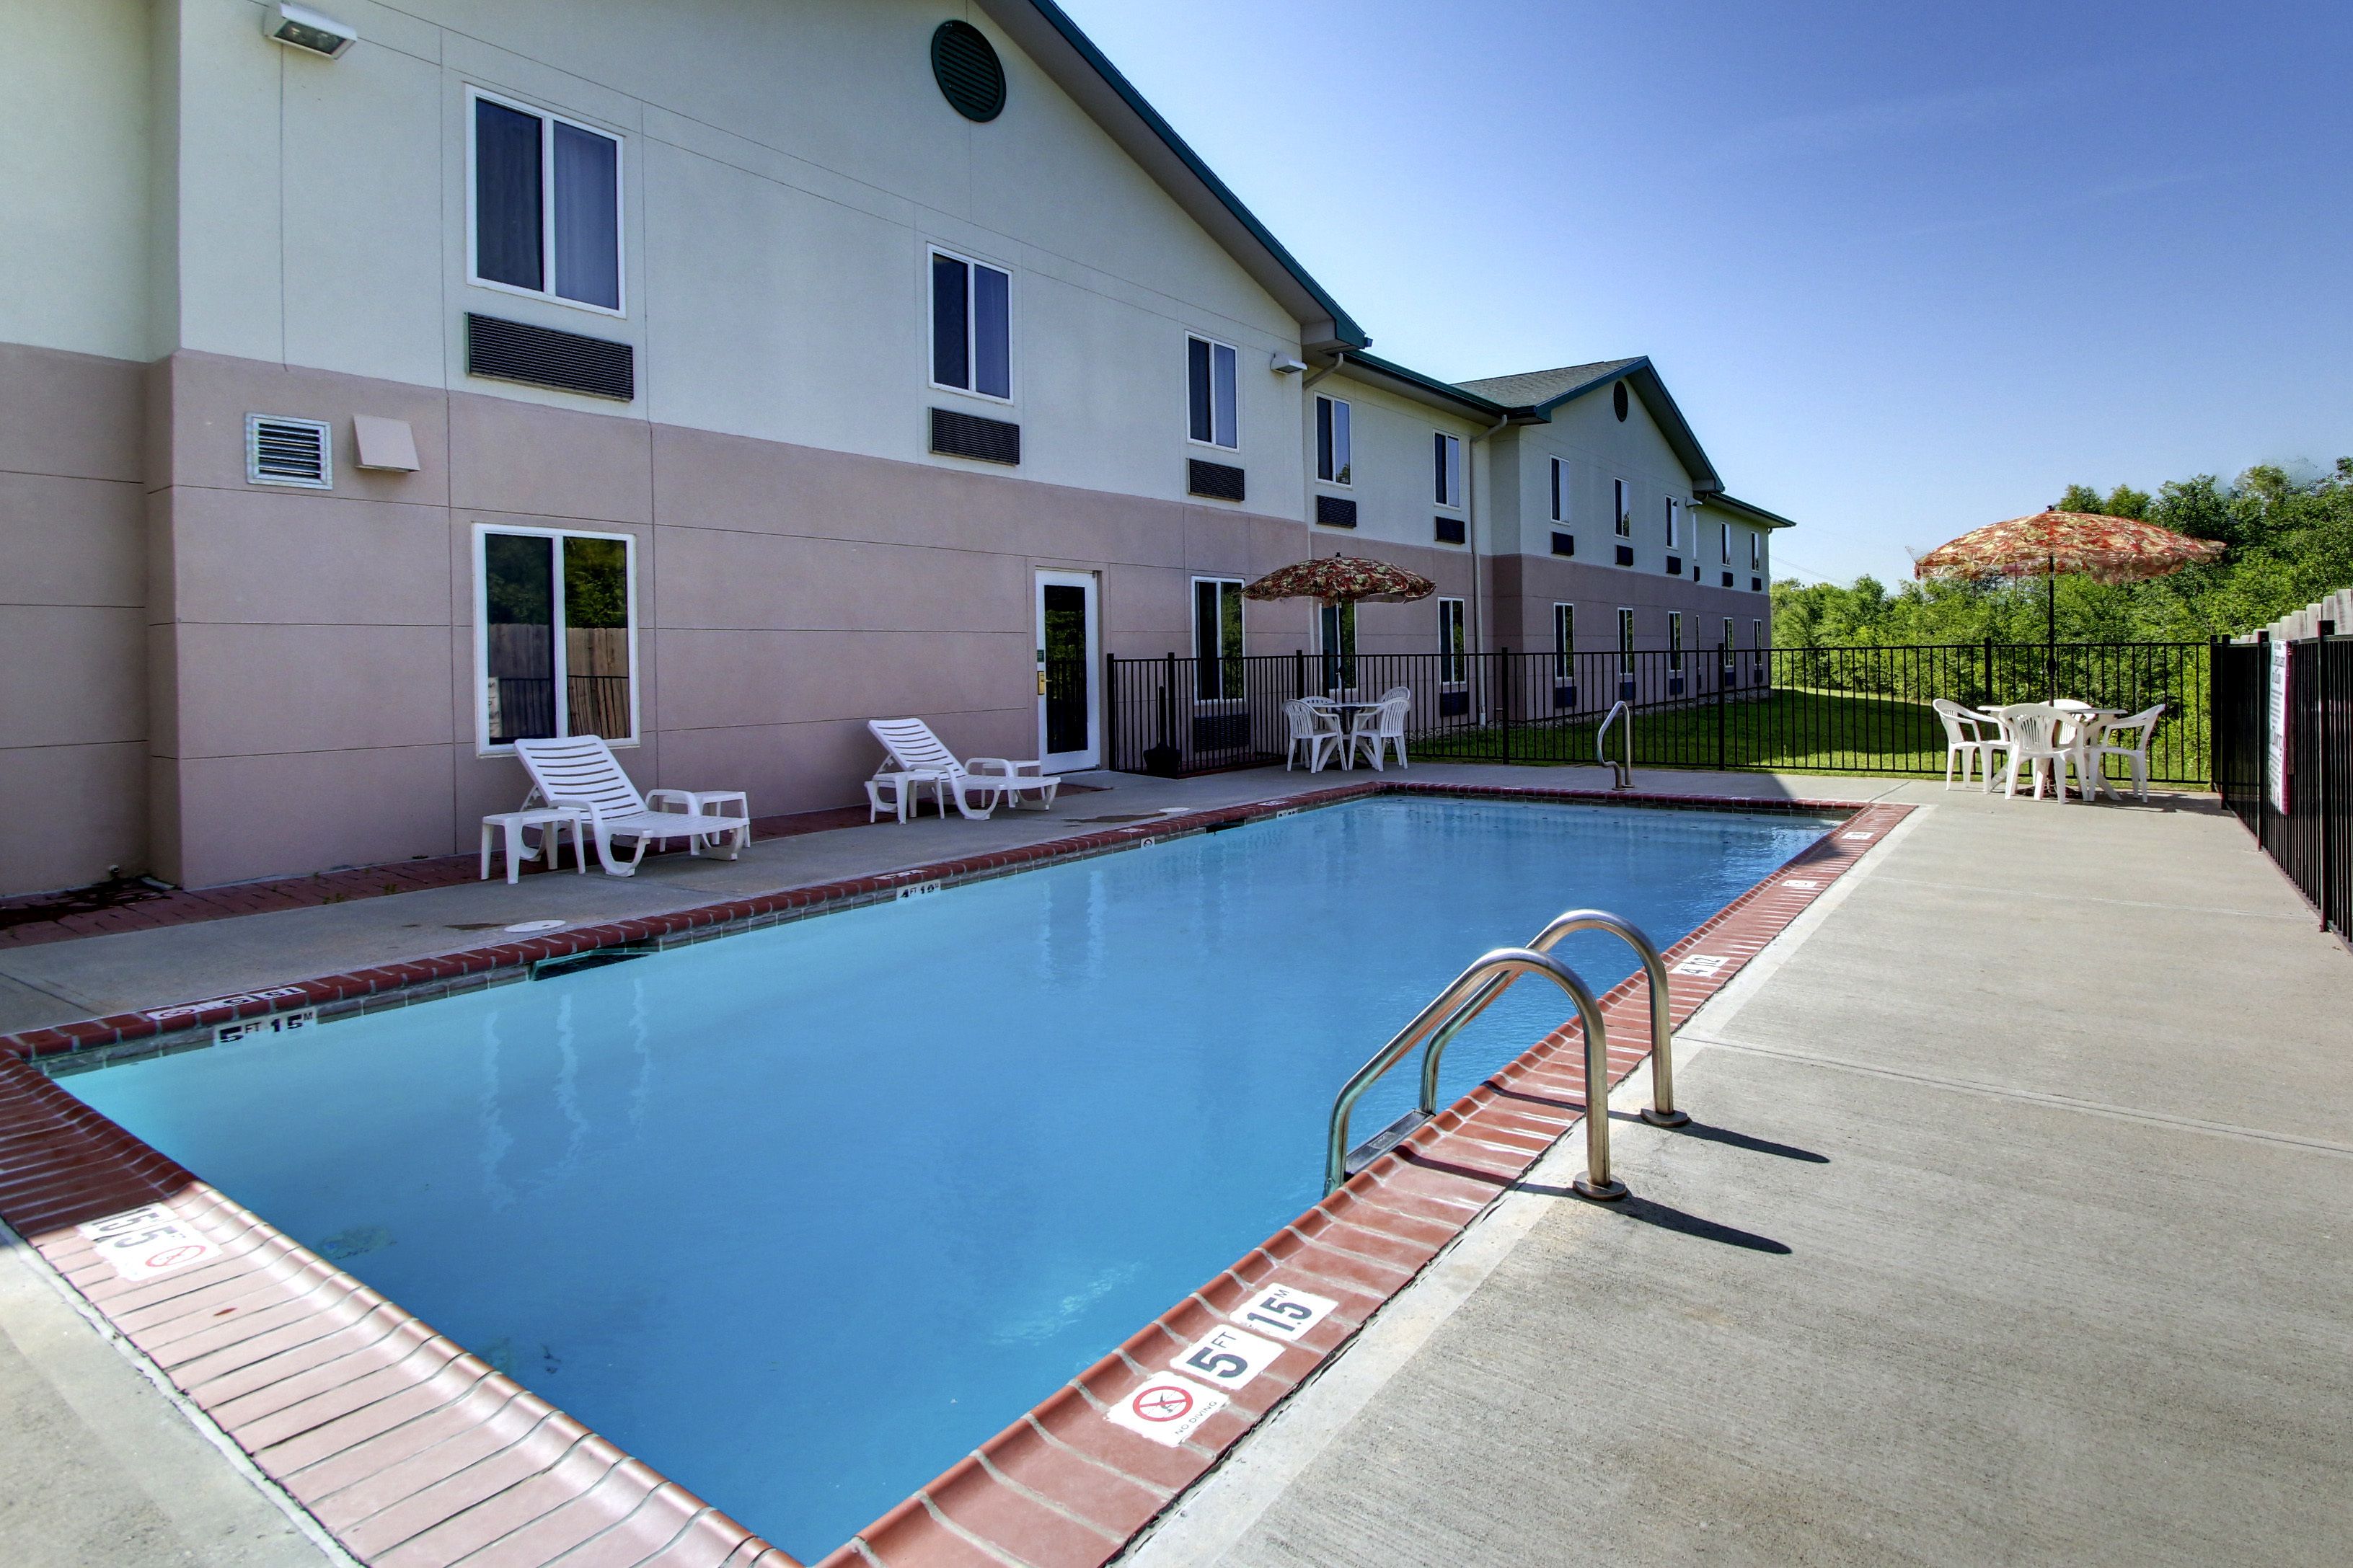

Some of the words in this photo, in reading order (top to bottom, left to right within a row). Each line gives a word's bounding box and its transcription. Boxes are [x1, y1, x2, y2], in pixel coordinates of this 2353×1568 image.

[219, 1025, 244, 1043] 5
[244, 1022, 262, 1034] FT
[114, 1226, 178, 1248] 5
[1273, 1289, 1290, 1298] M
[1211, 1331, 1238, 1350] FT
[1186, 1346, 1248, 1378] 5
[1174, 1424, 1189, 1435] NO
[1188, 1401, 1217, 1423] DIVING
